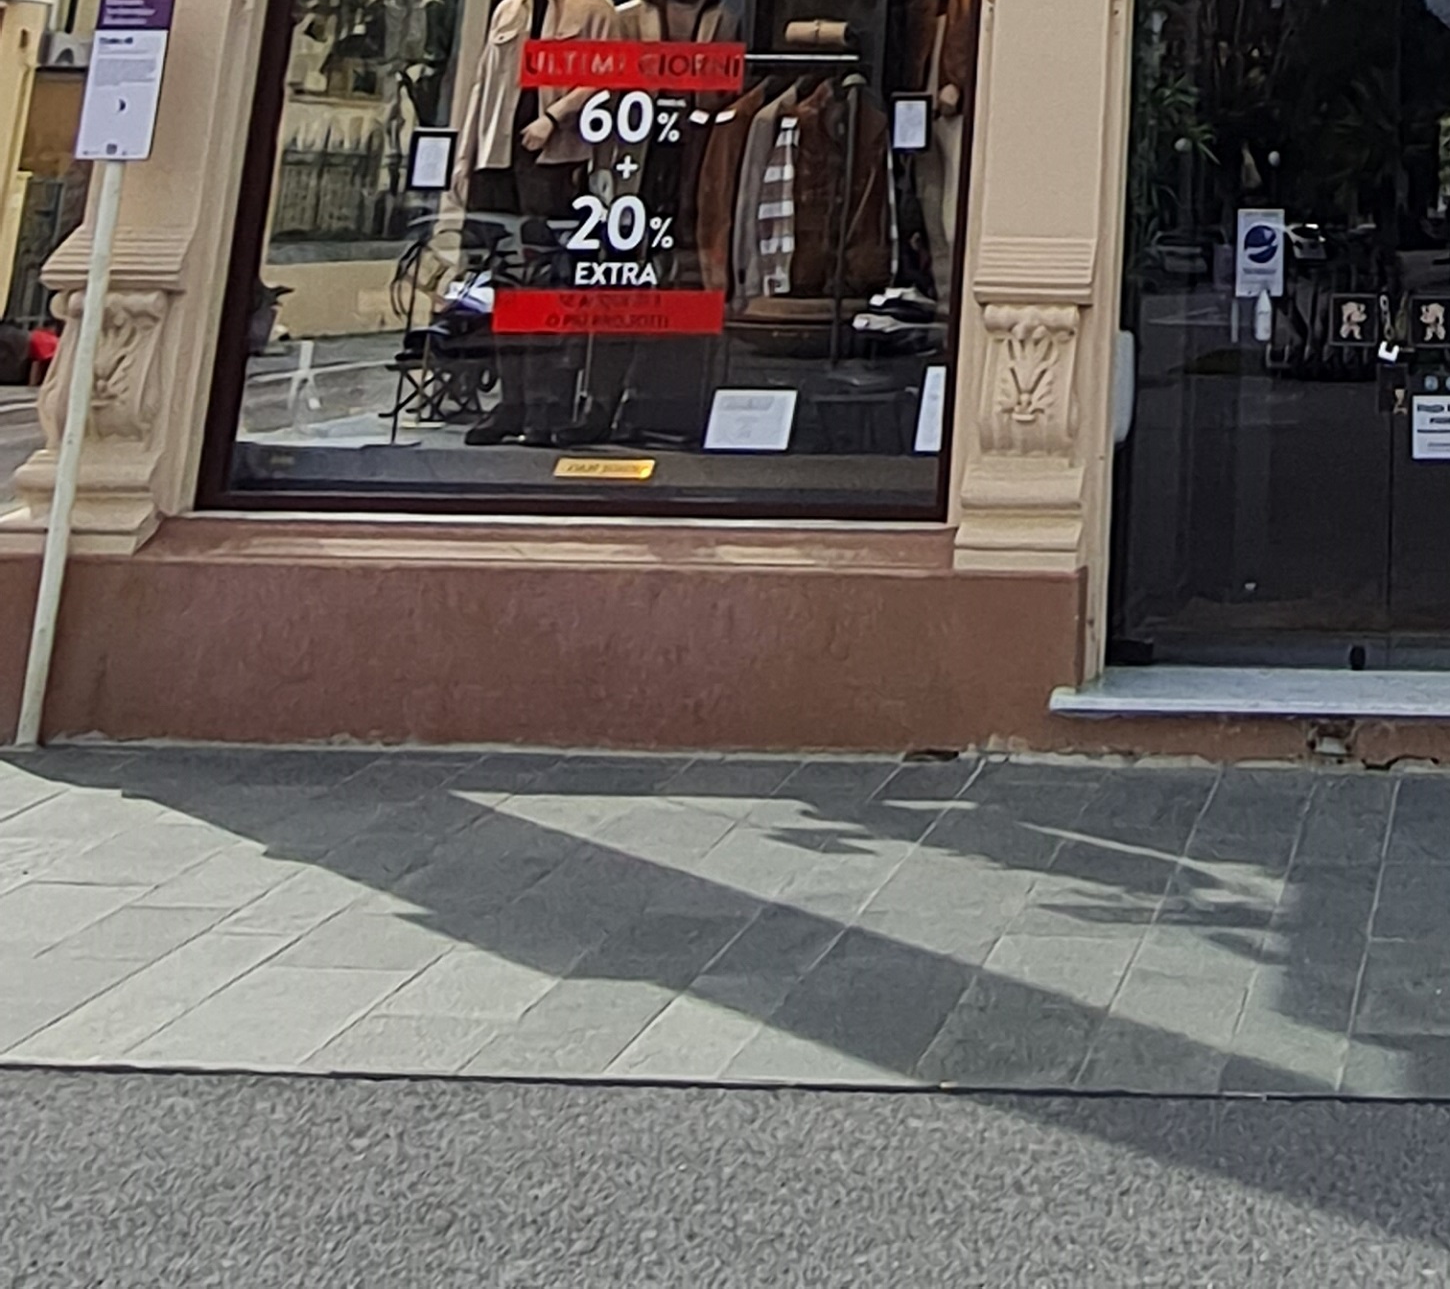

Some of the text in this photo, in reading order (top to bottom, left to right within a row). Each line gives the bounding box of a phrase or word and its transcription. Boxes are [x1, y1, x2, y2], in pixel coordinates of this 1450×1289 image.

[524, 51, 627, 76] ULTIMI
[566, 194, 674, 251] 20%
[574, 262, 658, 286] EXTRA
